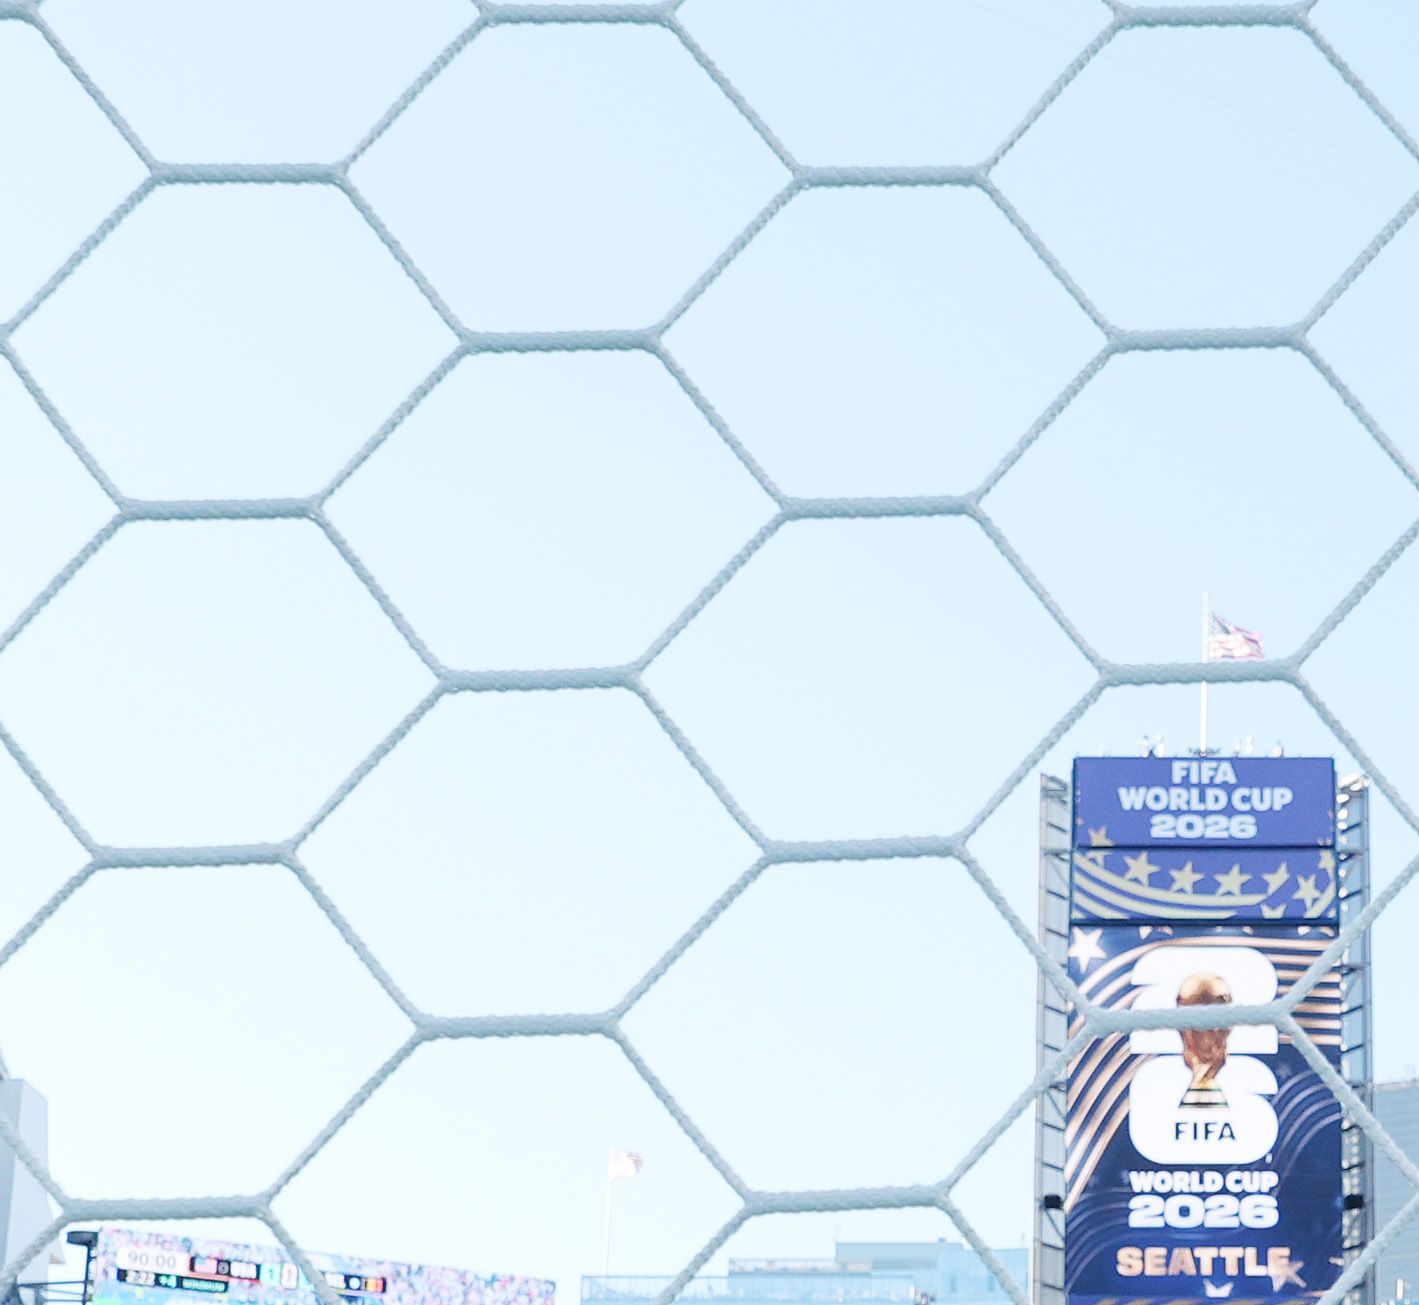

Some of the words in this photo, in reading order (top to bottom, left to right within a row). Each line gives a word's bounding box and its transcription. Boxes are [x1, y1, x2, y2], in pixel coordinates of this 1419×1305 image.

[1171, 761, 1237, 785] FIFA
[1118, 787, 1230, 812] WORLD
[1231, 787, 1294, 812] CUP
[1150, 814, 1258, 839] 2026
[1174, 1122, 1236, 1141] FIFA
[1128, 1171, 1225, 1193] WORLD
[1225, 1171, 1279, 1193] CUP
[1128, 1195, 1279, 1229] 2026
[128, 1251, 177, 1270] 90:00
[1116, 1246, 1292, 1278] SEATTLE
